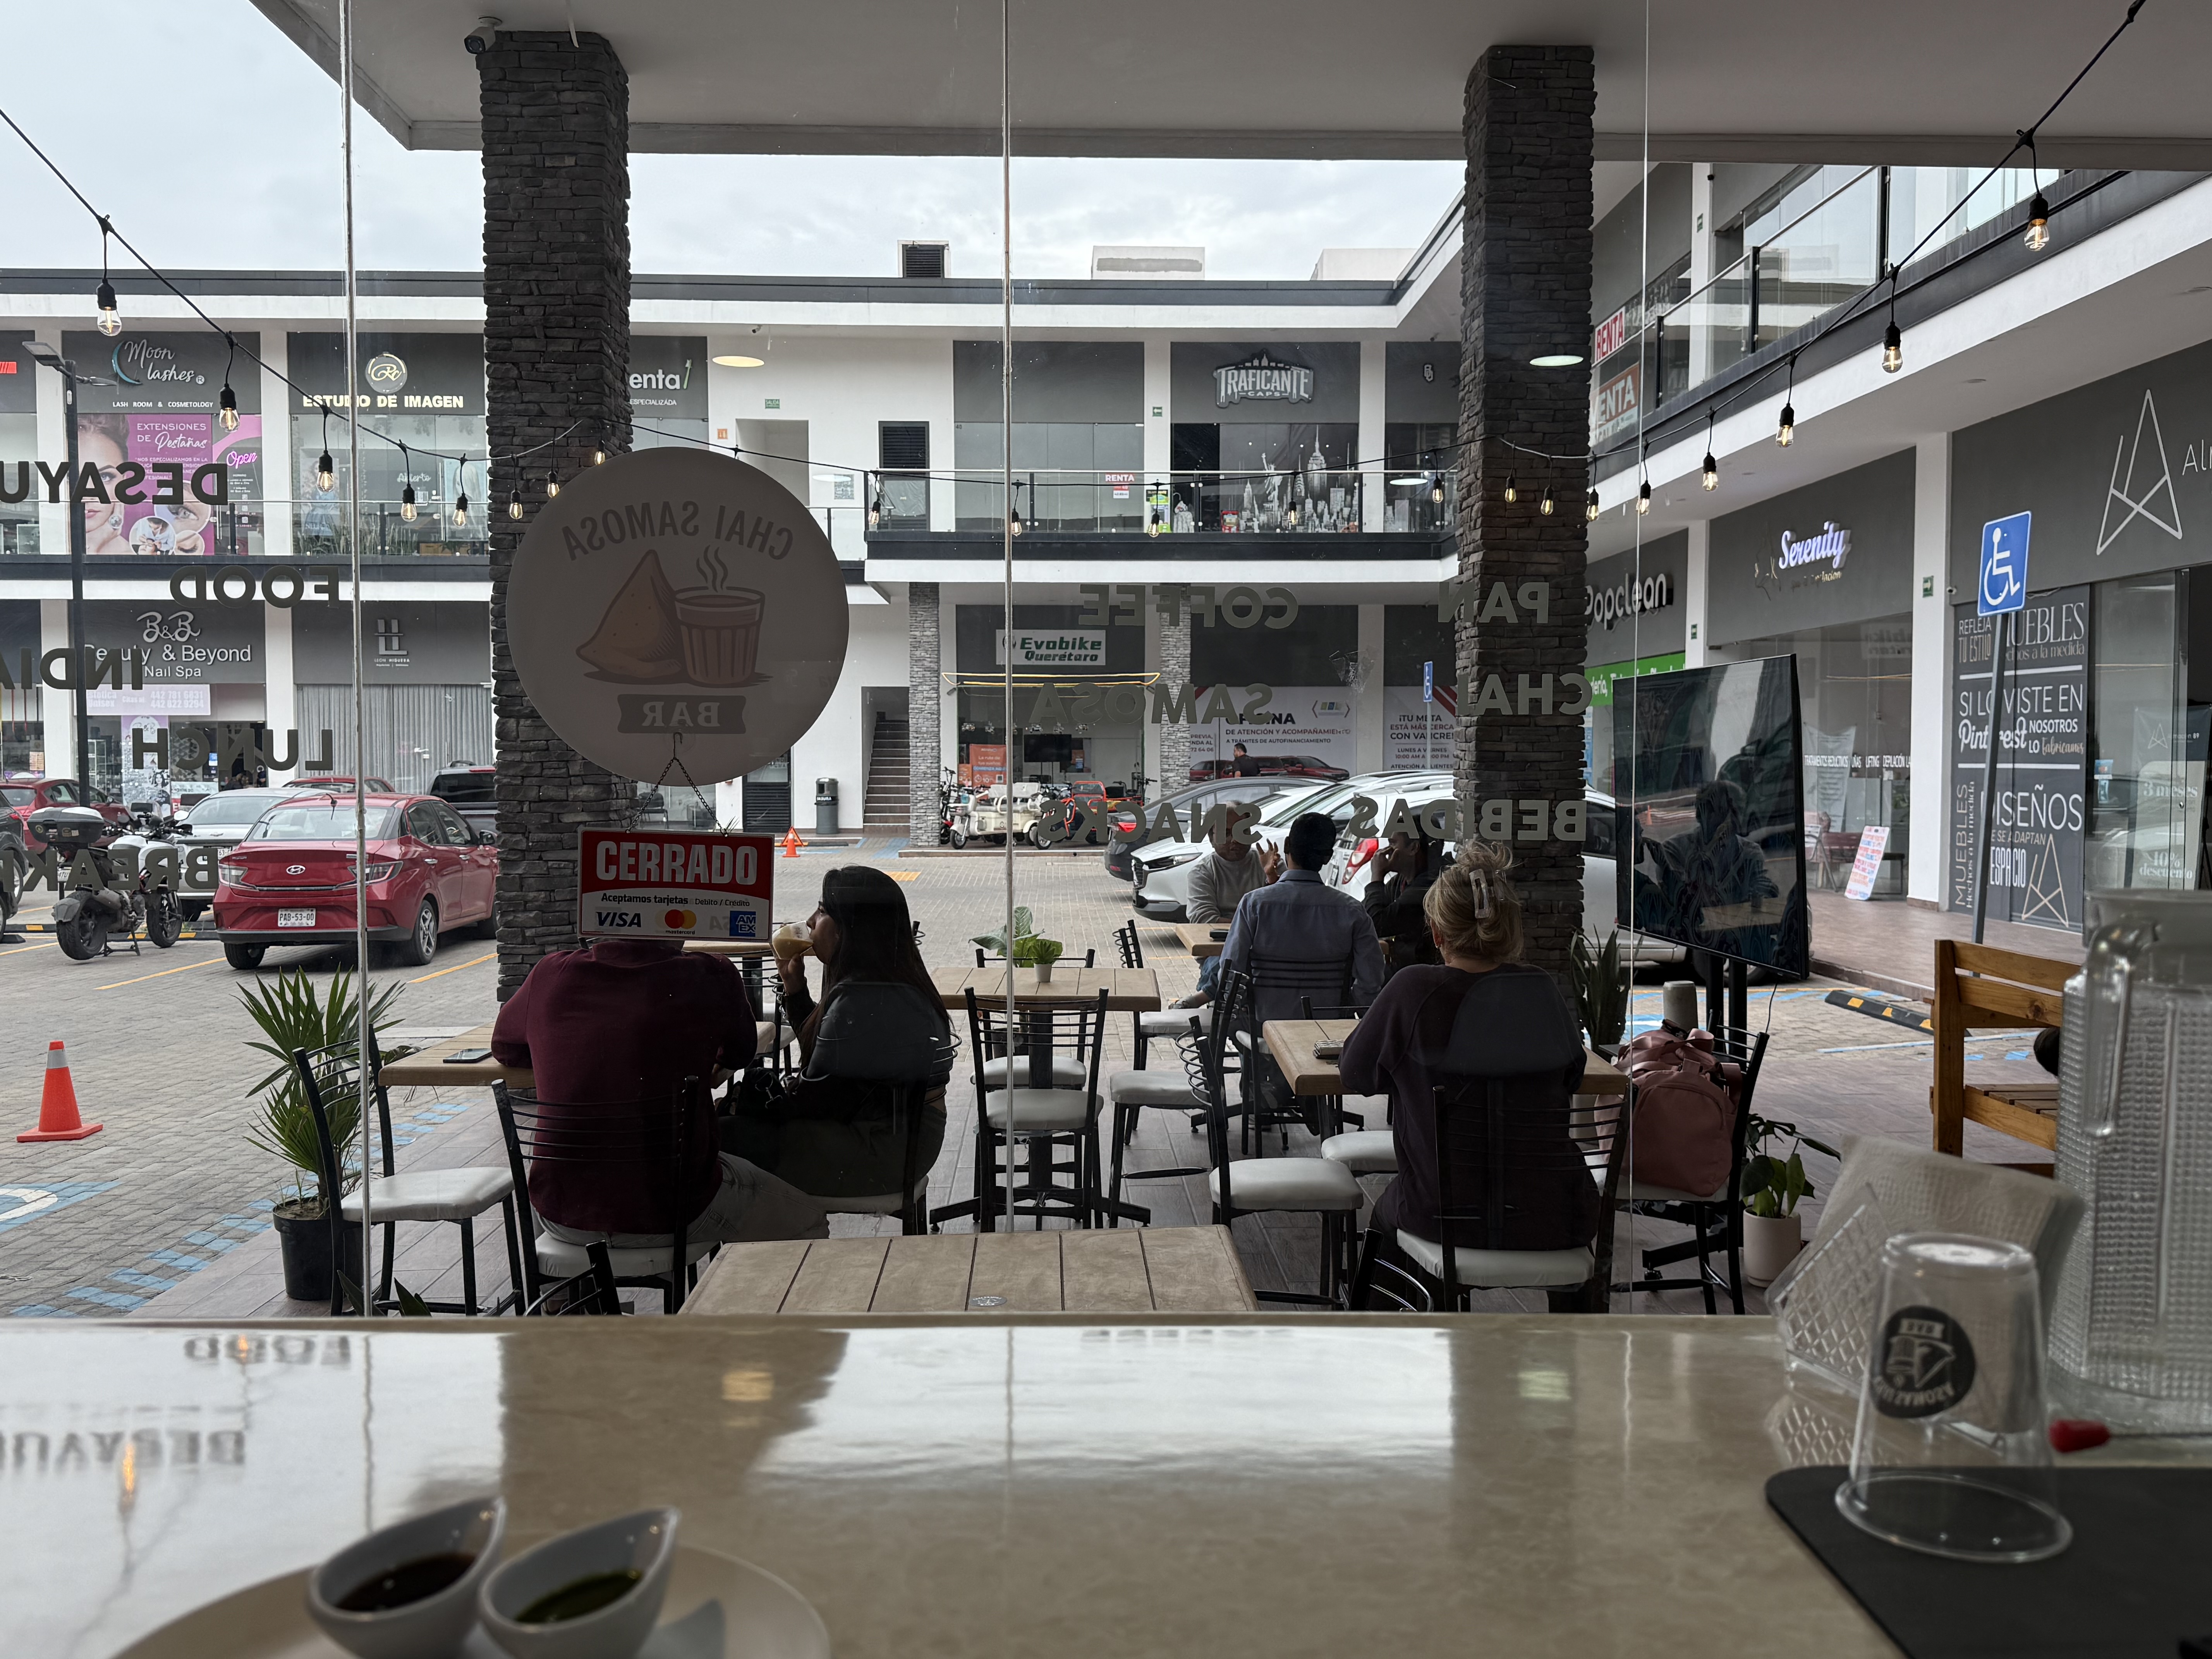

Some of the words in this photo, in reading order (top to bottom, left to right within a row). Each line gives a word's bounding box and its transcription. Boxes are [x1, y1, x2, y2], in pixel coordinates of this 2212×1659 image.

[1596, 311, 1625, 361] RENTA
[125, 339, 175, 368] Moon
[148, 362, 194, 382] lashes
[1217, 366, 1310, 402] TRAFICANTE
[303, 395, 370, 407] ESTUIO
[377, 395, 397, 407] DE
[404, 395, 464, 408] IMAGEN
[155, 431, 208, 452] Pestañas
[226, 451, 258, 469] Open
[1779, 521, 1848, 569] Serenity
[137, 611, 201, 643] B&B
[1959, 617, 1991, 635] REFLEJA
[1020, 637, 1102, 650] Evobike
[1958, 637, 1967, 663] TU
[1970, 634, 1991, 662] ESTILO
[2032, 649, 2038, 659] a
[2040, 644, 2048, 659] la
[2051, 641, 2085, 657] medida
[84, 644, 151, 665] euy
[162, 644, 176, 661] &
[182, 645, 251, 665] Beyond
[1024, 651, 1099, 661] Querétaro
[144, 666, 171, 677] Nail
[175, 666, 201, 680] Spa
[1960, 691, 1972, 716] SI
[2003, 686, 2053, 714] VISTE
[2059, 684, 2083, 712] EN
[1958, 716, 2027, 753] Pintest
[2029, 719, 2078, 733] NOSOTROS
[2028, 740, 2040, 753] LO
[1865, 756, 1880, 768] LIFTING
[1882, 753, 1905, 768] DEPILACIÓN
[1955, 784, 1968, 905] MUEBLES
[1997, 830, 2007, 842] SE
[2008, 831, 2046, 845] ADAPTAN
[596, 840, 757, 885] CERRADO
[1990, 847, 2026, 888] ESPACIO
[601, 893, 652, 904] Aceptamos
[654, 895, 689, 906] tarjetas
[725, 899, 750, 907] Crédito
[279, 912, 314, 922] PAB-53-00
[596, 911, 642, 928] VISA
[736, 915, 756, 924] AM
[738, 924, 756, 933] EX
